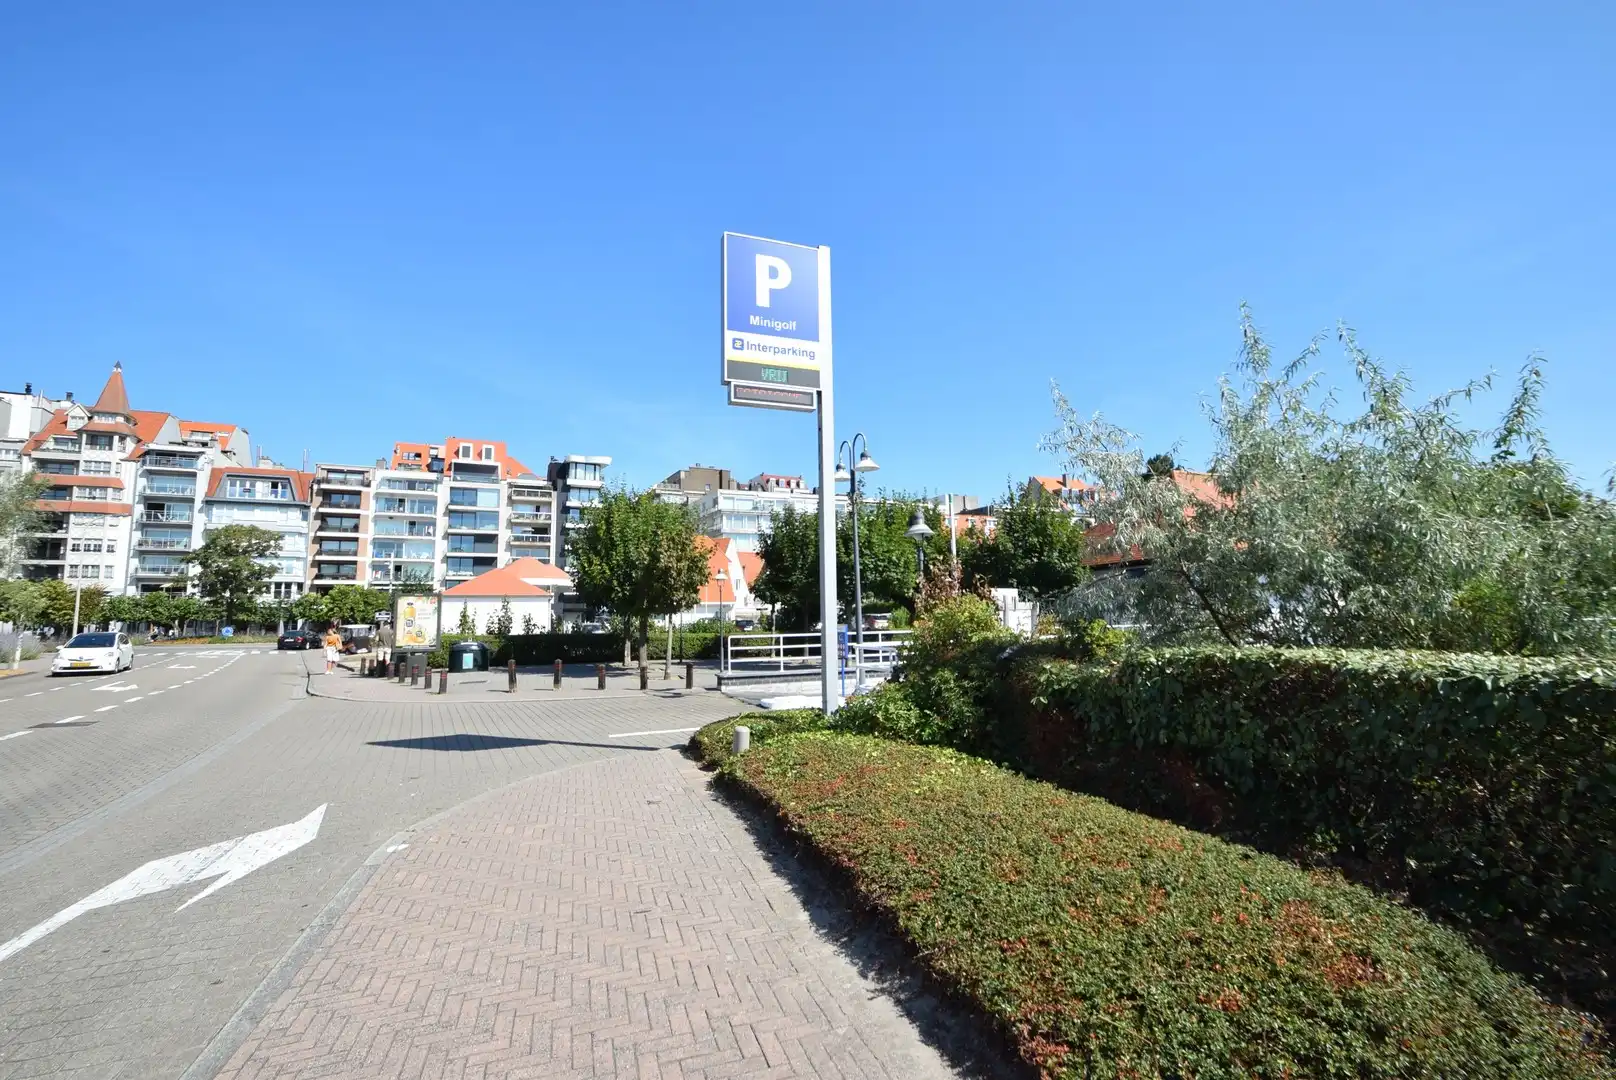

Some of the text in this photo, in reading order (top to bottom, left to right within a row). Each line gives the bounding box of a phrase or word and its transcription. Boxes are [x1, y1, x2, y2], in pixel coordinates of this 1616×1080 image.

[755, 253, 792, 309] P
[749, 315, 797, 332] Minigolf
[746, 340, 816, 361] Interparking
